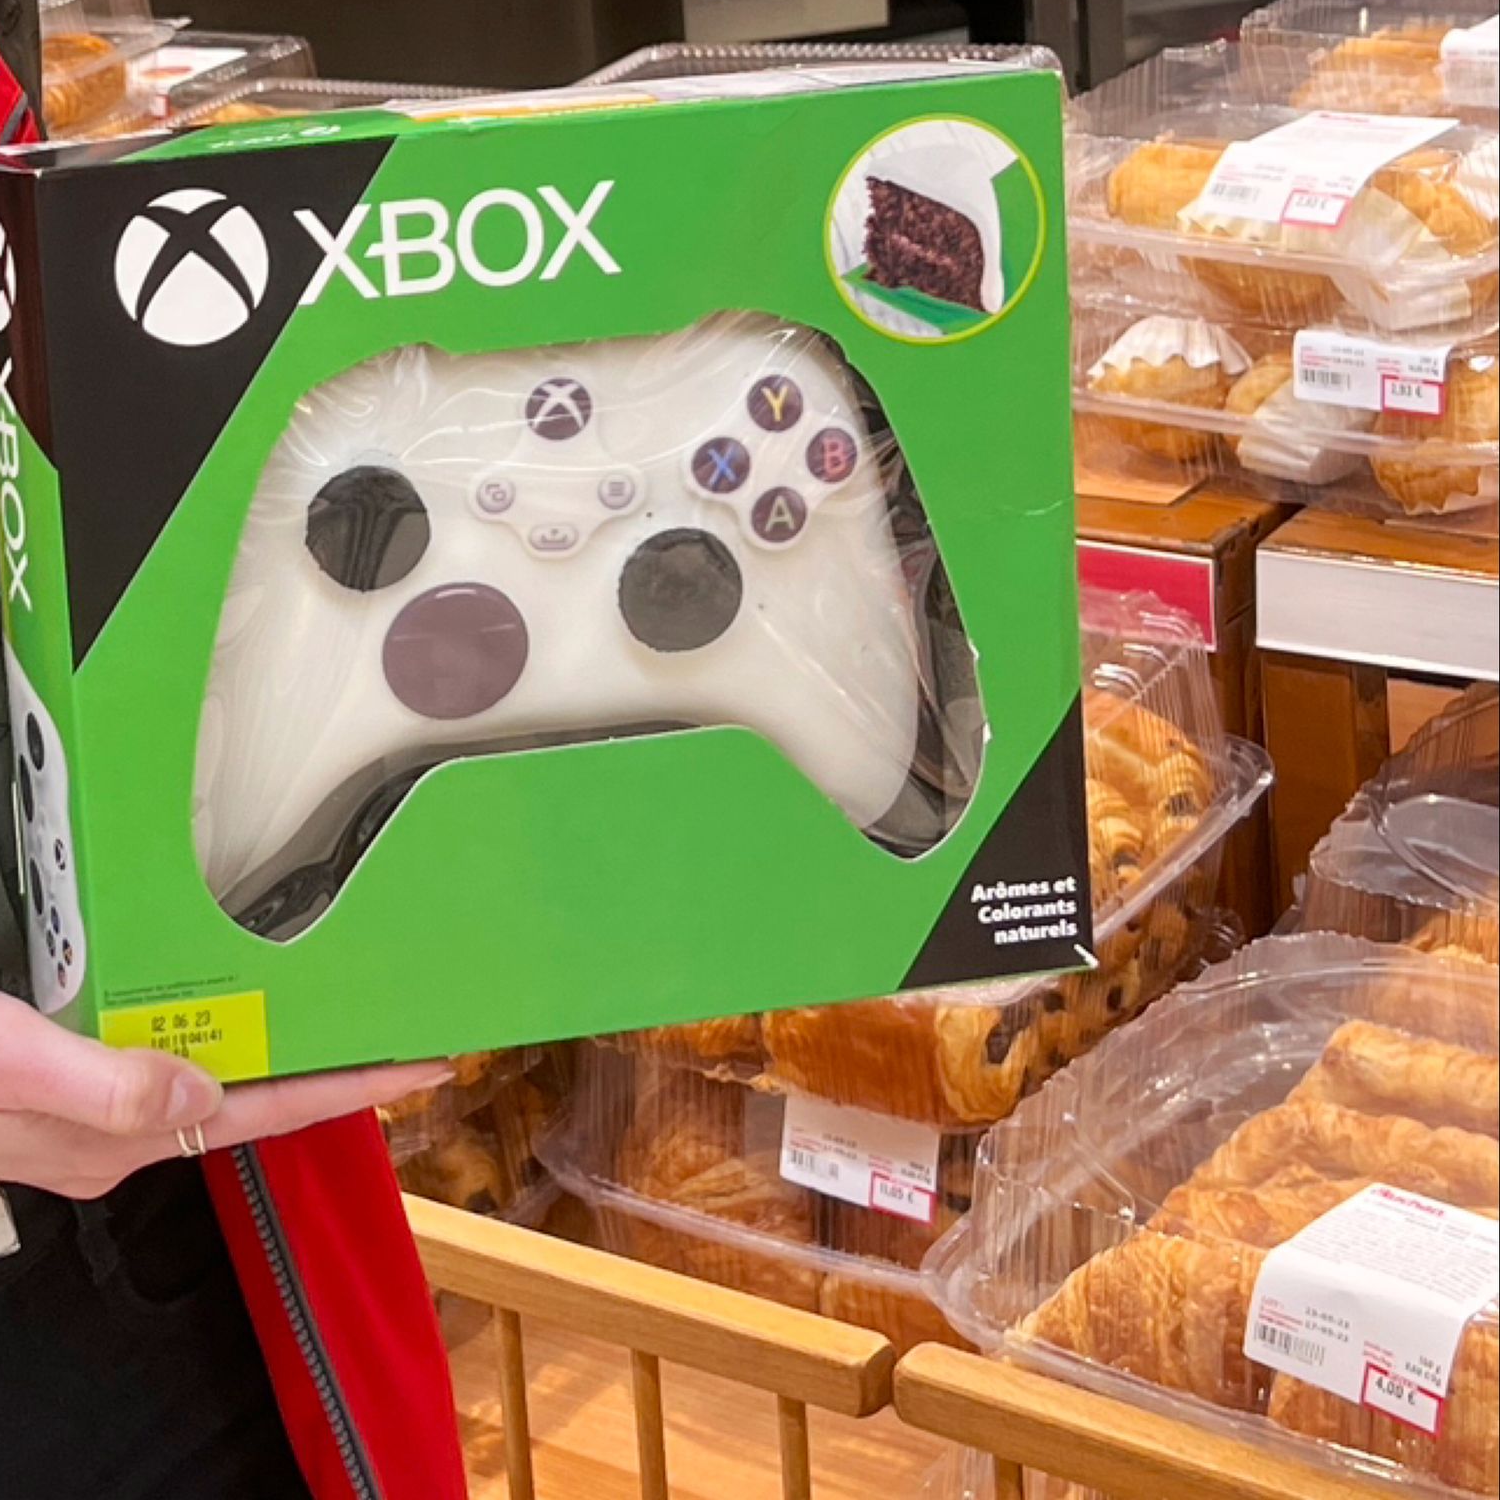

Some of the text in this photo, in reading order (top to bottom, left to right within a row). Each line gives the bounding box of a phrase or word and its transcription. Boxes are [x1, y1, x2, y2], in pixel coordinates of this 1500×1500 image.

[293, 180, 622, 305] XBOX
[761, 386, 790, 422] Y
[708, 438, 847, 488] X B
[764, 495, 796, 532] A
[971, 875, 1077, 903] Arômes et
[978, 899, 1077, 924] Colorants
[994, 918, 1078, 944] naturels
[195, 1009, 211, 1028] 23
